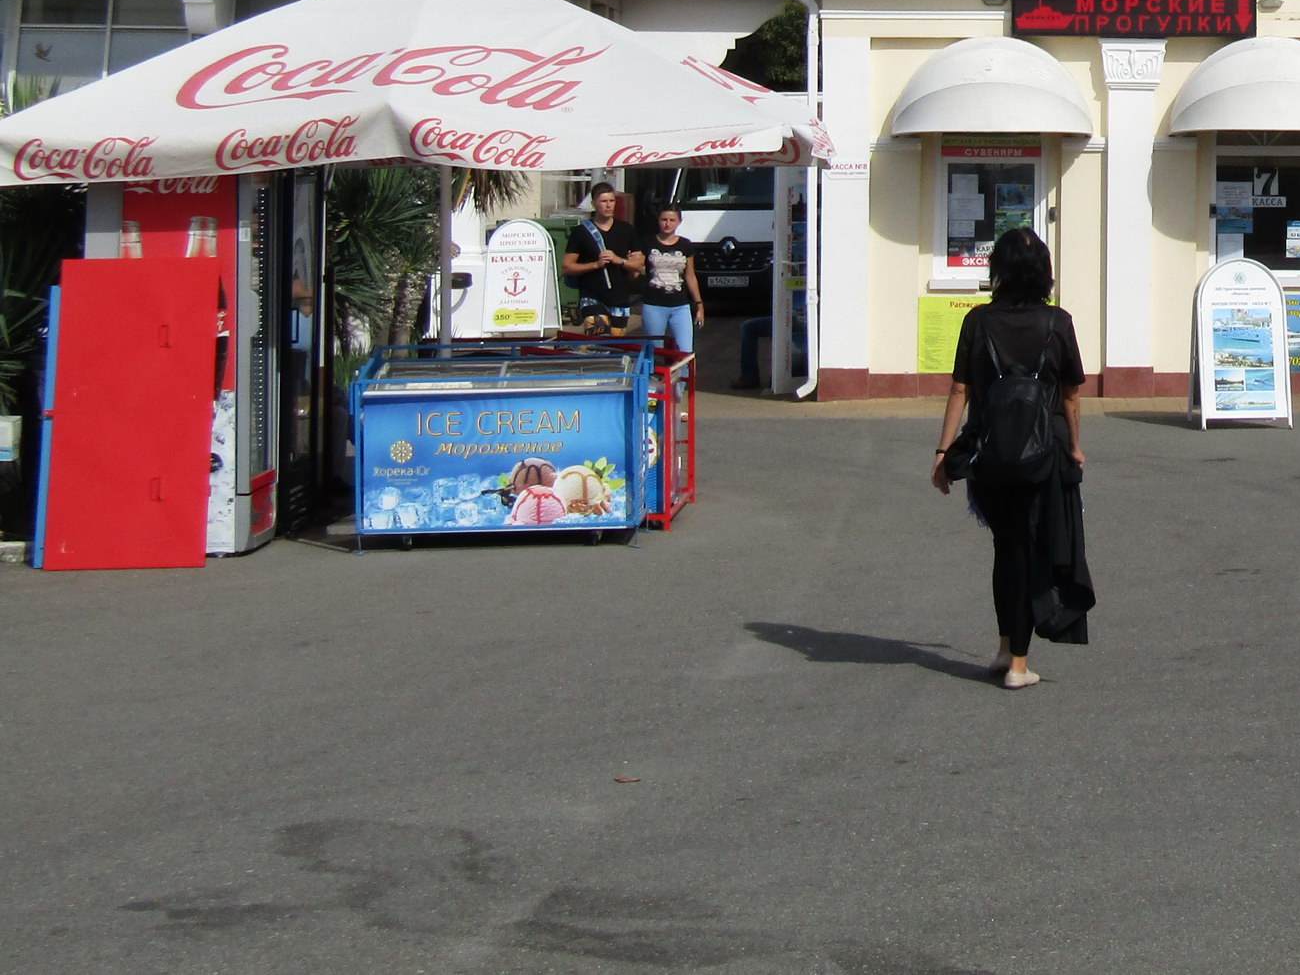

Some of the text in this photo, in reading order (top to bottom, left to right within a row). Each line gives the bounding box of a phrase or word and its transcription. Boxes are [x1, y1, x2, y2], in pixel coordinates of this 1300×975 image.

[1075, 15, 1232, 34] ПРОГУЛКИ
[175, 43, 614, 112] Coca-Cola
[215, 115, 361, 171] Coca-Cola
[409, 118, 556, 170] Coca-Cola
[964, 148, 1022, 156] СУВЕНИРЫ
[13, 136, 159, 182] Coca-Cola
[1255, 167, 1278, 196] 7
[1252, 197, 1283, 206] КАССА
[491, 255, 523, 263] КАССА
[416, 409, 582, 437] ICE CREAM
